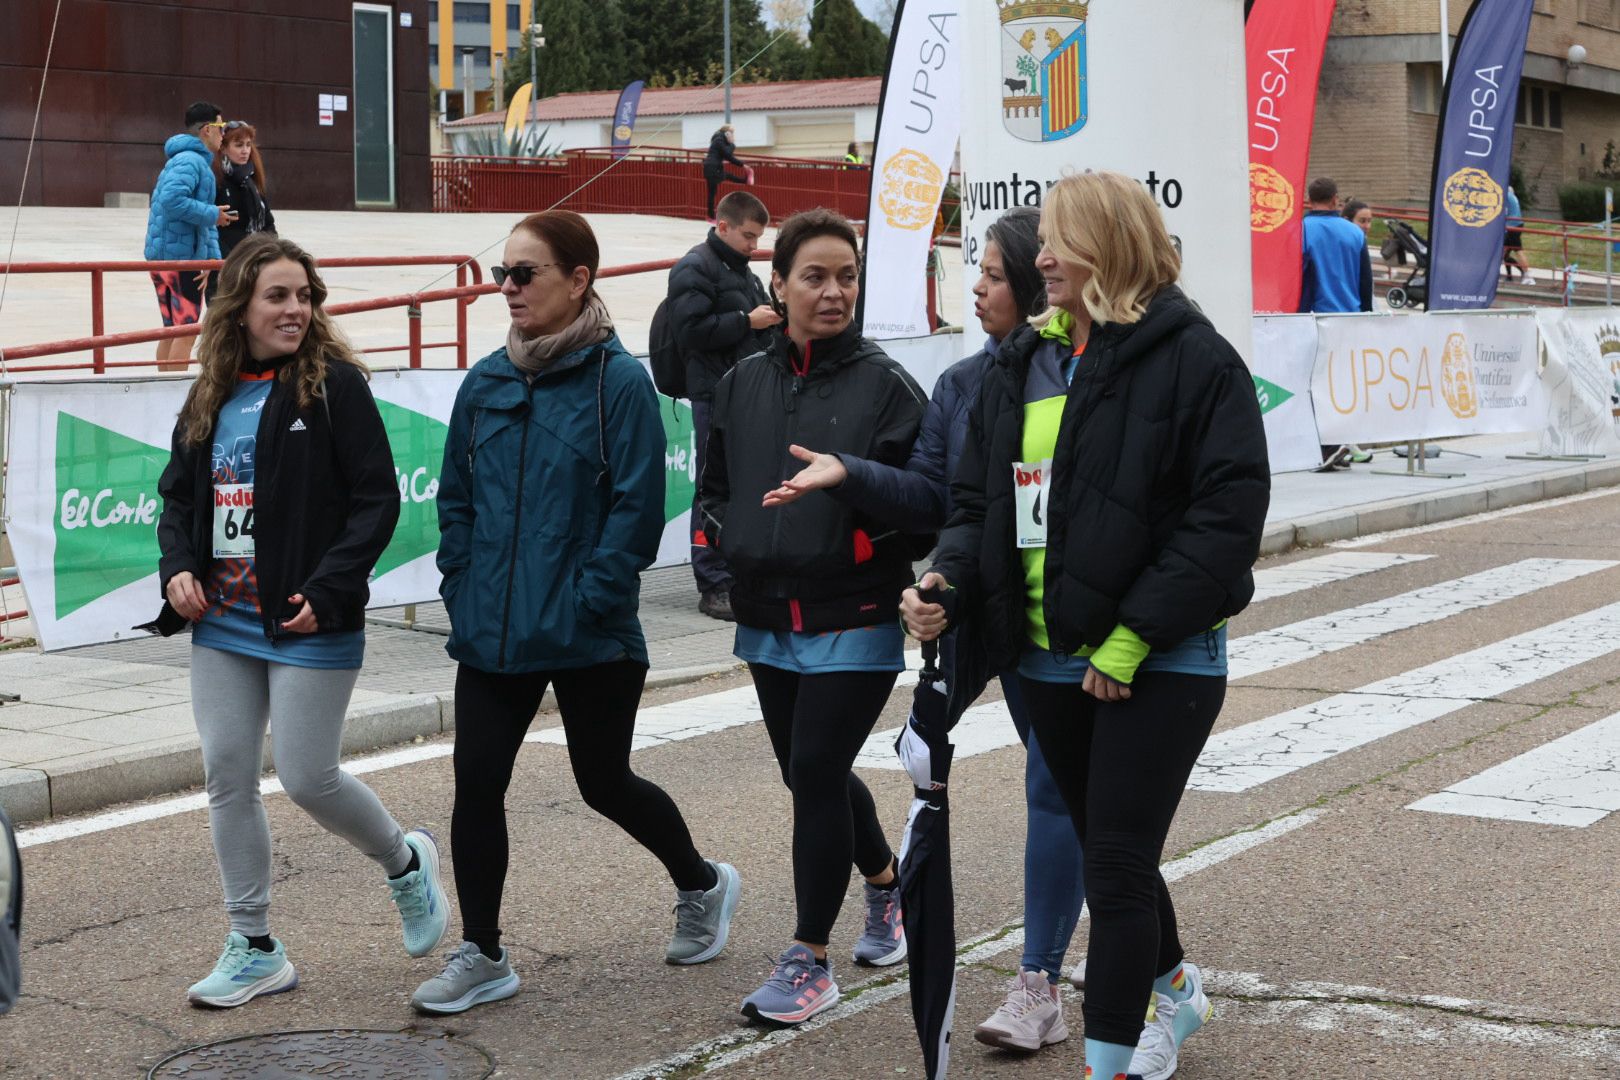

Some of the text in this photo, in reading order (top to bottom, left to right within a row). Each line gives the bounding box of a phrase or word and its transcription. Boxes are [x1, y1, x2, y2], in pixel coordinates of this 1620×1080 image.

[905, 13, 957, 134] UPSA
[1252, 48, 1296, 152] UPSA
[1465, 65, 1503, 157] UPSA
[1327, 346, 1435, 415] UPSA
[61, 488, 90, 530] El
[91, 488, 158, 528] Corte
[215, 488, 255, 508] bedu
